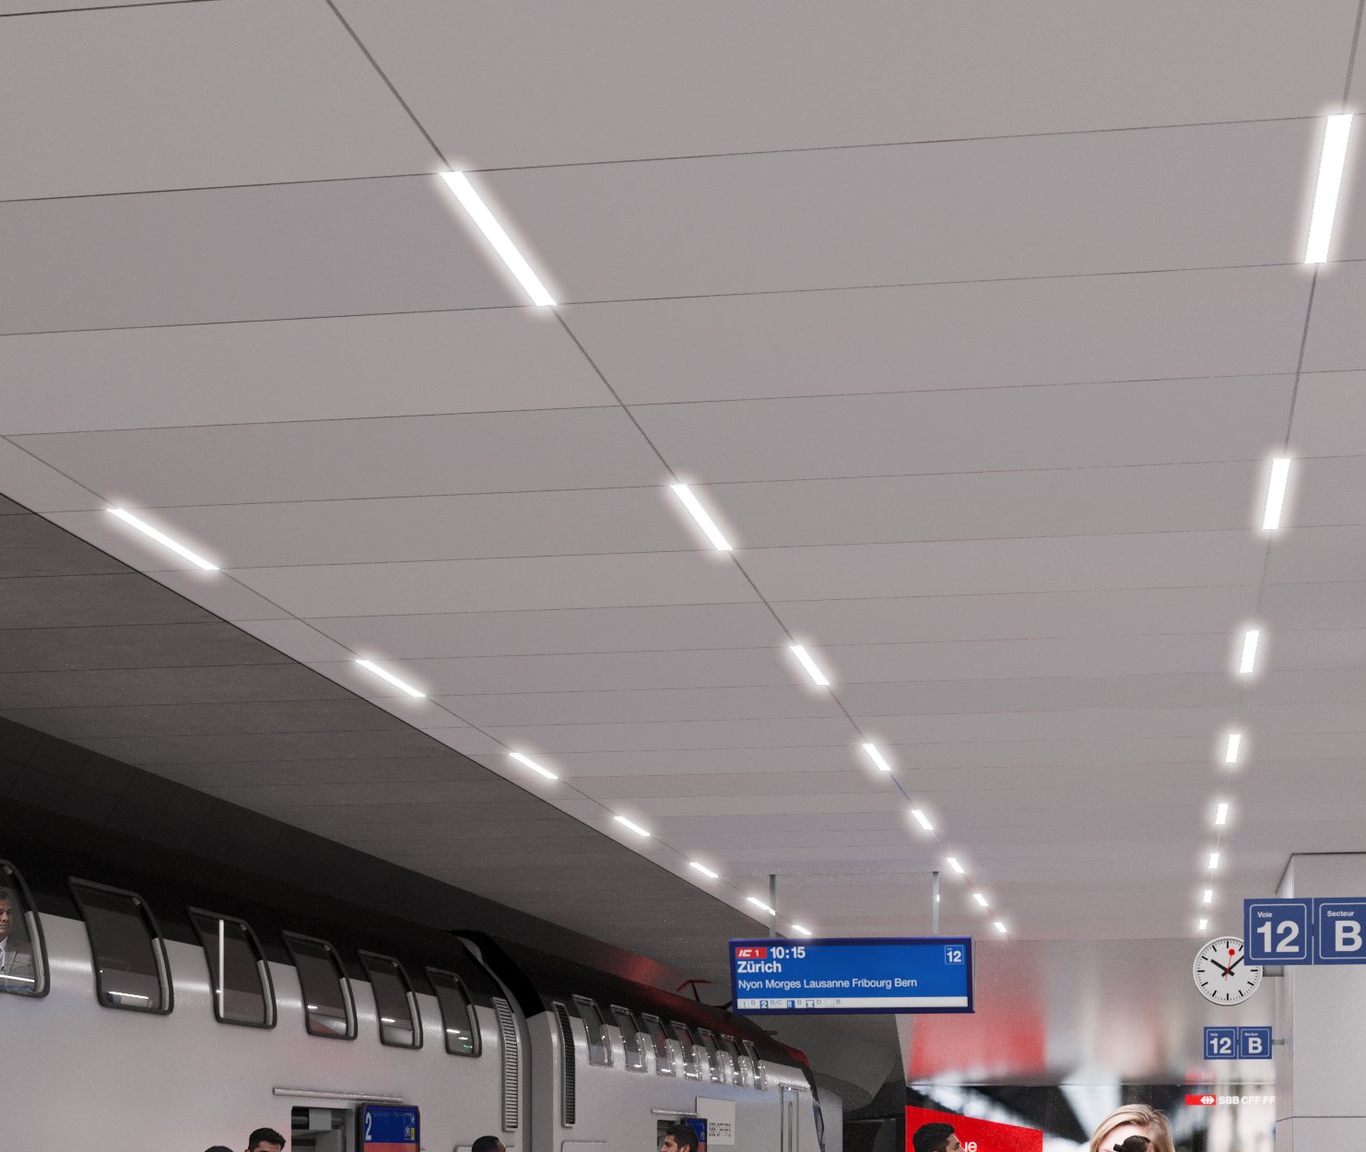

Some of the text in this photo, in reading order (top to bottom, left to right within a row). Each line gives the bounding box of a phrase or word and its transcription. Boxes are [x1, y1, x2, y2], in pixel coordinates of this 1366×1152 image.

[1257, 920, 1299, 952] 12
[1335, 920, 1362, 951] B
[770, 946, 806, 959] 10:15
[947, 951, 962, 963] 12
[737, 960, 782, 973] Zürich
[738, 978, 918, 991] Nyon Morges Lausanne Fribourg Bern
[1210, 1038, 1232, 1054] 12
[1249, 1038, 1263, 1054] B
[1218, 1096, 1240, 1105] SBB
[1241, 1096, 1261, 1105] CFF
[365, 1112, 372, 1141] 2
